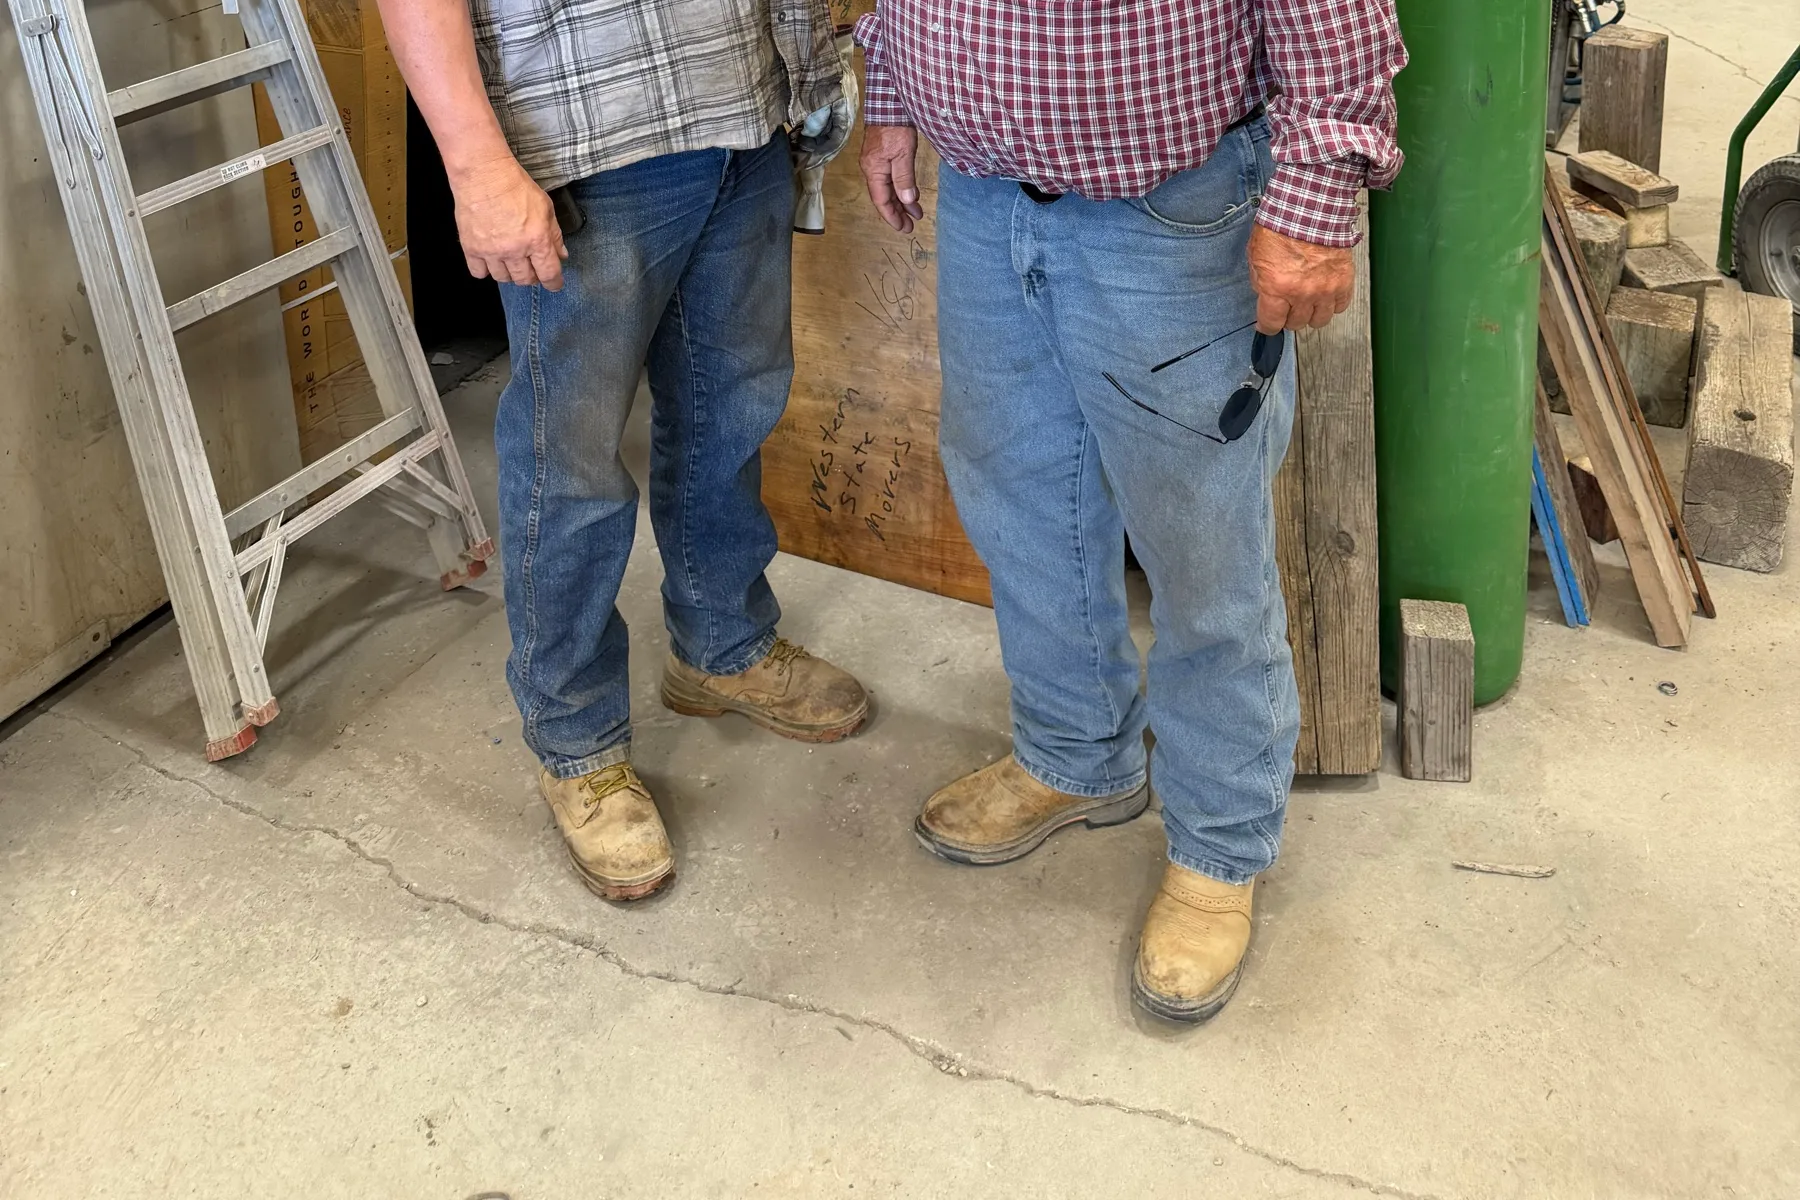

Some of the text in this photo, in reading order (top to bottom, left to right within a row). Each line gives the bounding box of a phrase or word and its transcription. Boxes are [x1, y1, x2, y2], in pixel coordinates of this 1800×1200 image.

[298, 280, 313, 359] WORD
[306, 371, 318, 414] THE
[810, 387, 861, 513] Western
